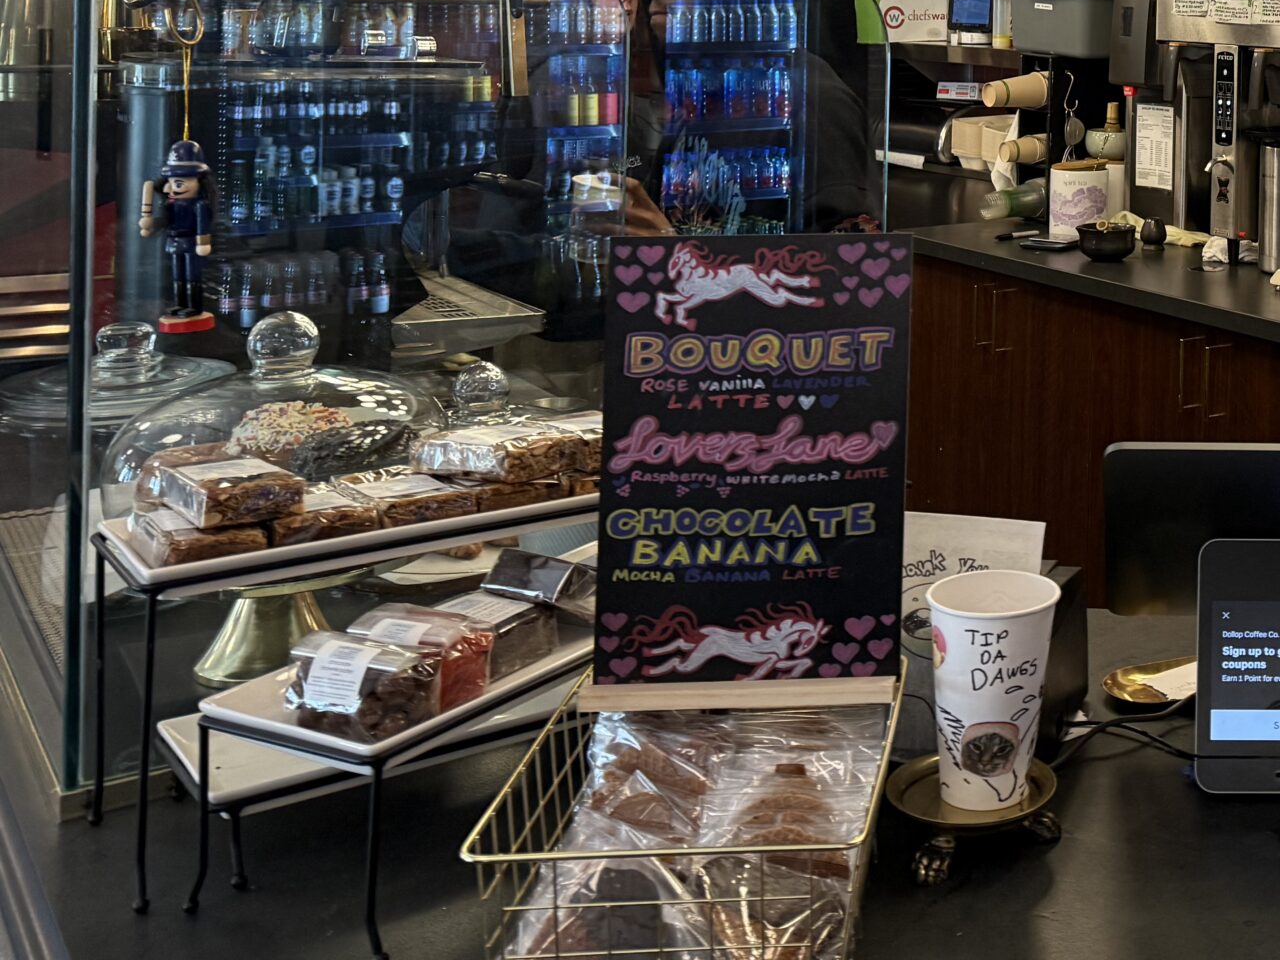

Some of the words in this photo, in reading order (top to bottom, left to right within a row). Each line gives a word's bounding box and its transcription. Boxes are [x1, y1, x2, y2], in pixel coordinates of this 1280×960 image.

[907, 8, 948, 22] chefswa
[623, 327, 895, 378] BOUQUET
[640, 379, 689, 393] ROSE
[772, 376, 872, 388] LAVENDER
[667, 394, 771, 410] LATTE
[630, 469, 718, 488] Raspberry
[844, 467, 889, 480] LATTE
[606, 502, 877, 540] CHOCOLATE
[628, 538, 823, 569] BANANA
[611, 568, 676, 583] MOCHA
[684, 569, 771, 583] BANANA
[781, 566, 843, 581] LATTE
[964, 629, 1009, 647] TIP
[1222, 630, 1243, 639] Dollop
[1244, 630, 1268, 638] Coffee
[1268, 630, 1280, 638] Co.
[1222, 646, 1247, 658] Sign
[1248, 649, 1262, 658] up
[1263, 647, 1276, 657] to
[1222, 661, 1267, 670] coupons
[970, 658, 1038, 692] DAWGS
[1221, 674, 1238, 682] Earn
[1244, 674, 1262, 682] Point
[1262, 674, 1273, 682] for
